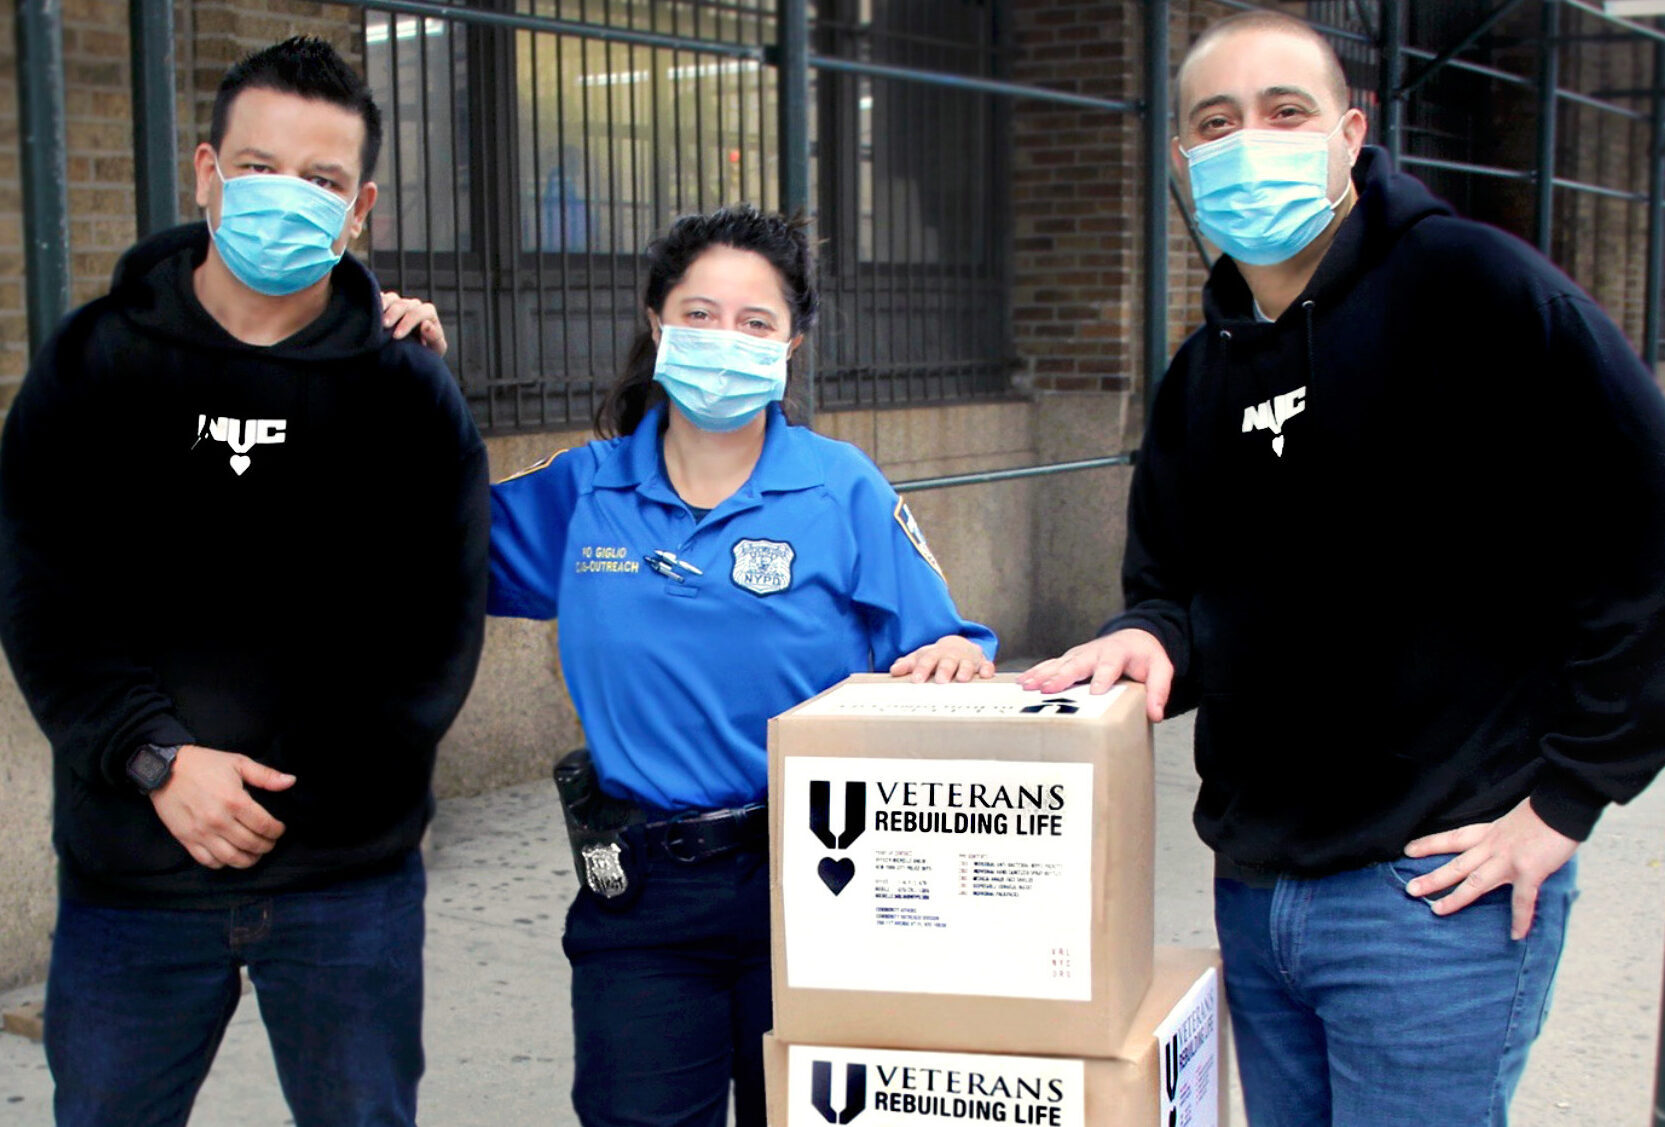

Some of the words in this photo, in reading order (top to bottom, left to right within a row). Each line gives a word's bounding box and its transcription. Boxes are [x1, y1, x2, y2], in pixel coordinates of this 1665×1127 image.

[595, 547, 627, 559] GIGLIO
[876, 781, 1064, 810] VETERANS
[875, 810, 1008, 835] REBUILDING
[1016, 814, 1062, 836] LIFE
[876, 1065, 1063, 1103] VETERANS
[875, 1091, 1007, 1122] REBUILDING
[1015, 1103, 1062, 1127] LIFE
